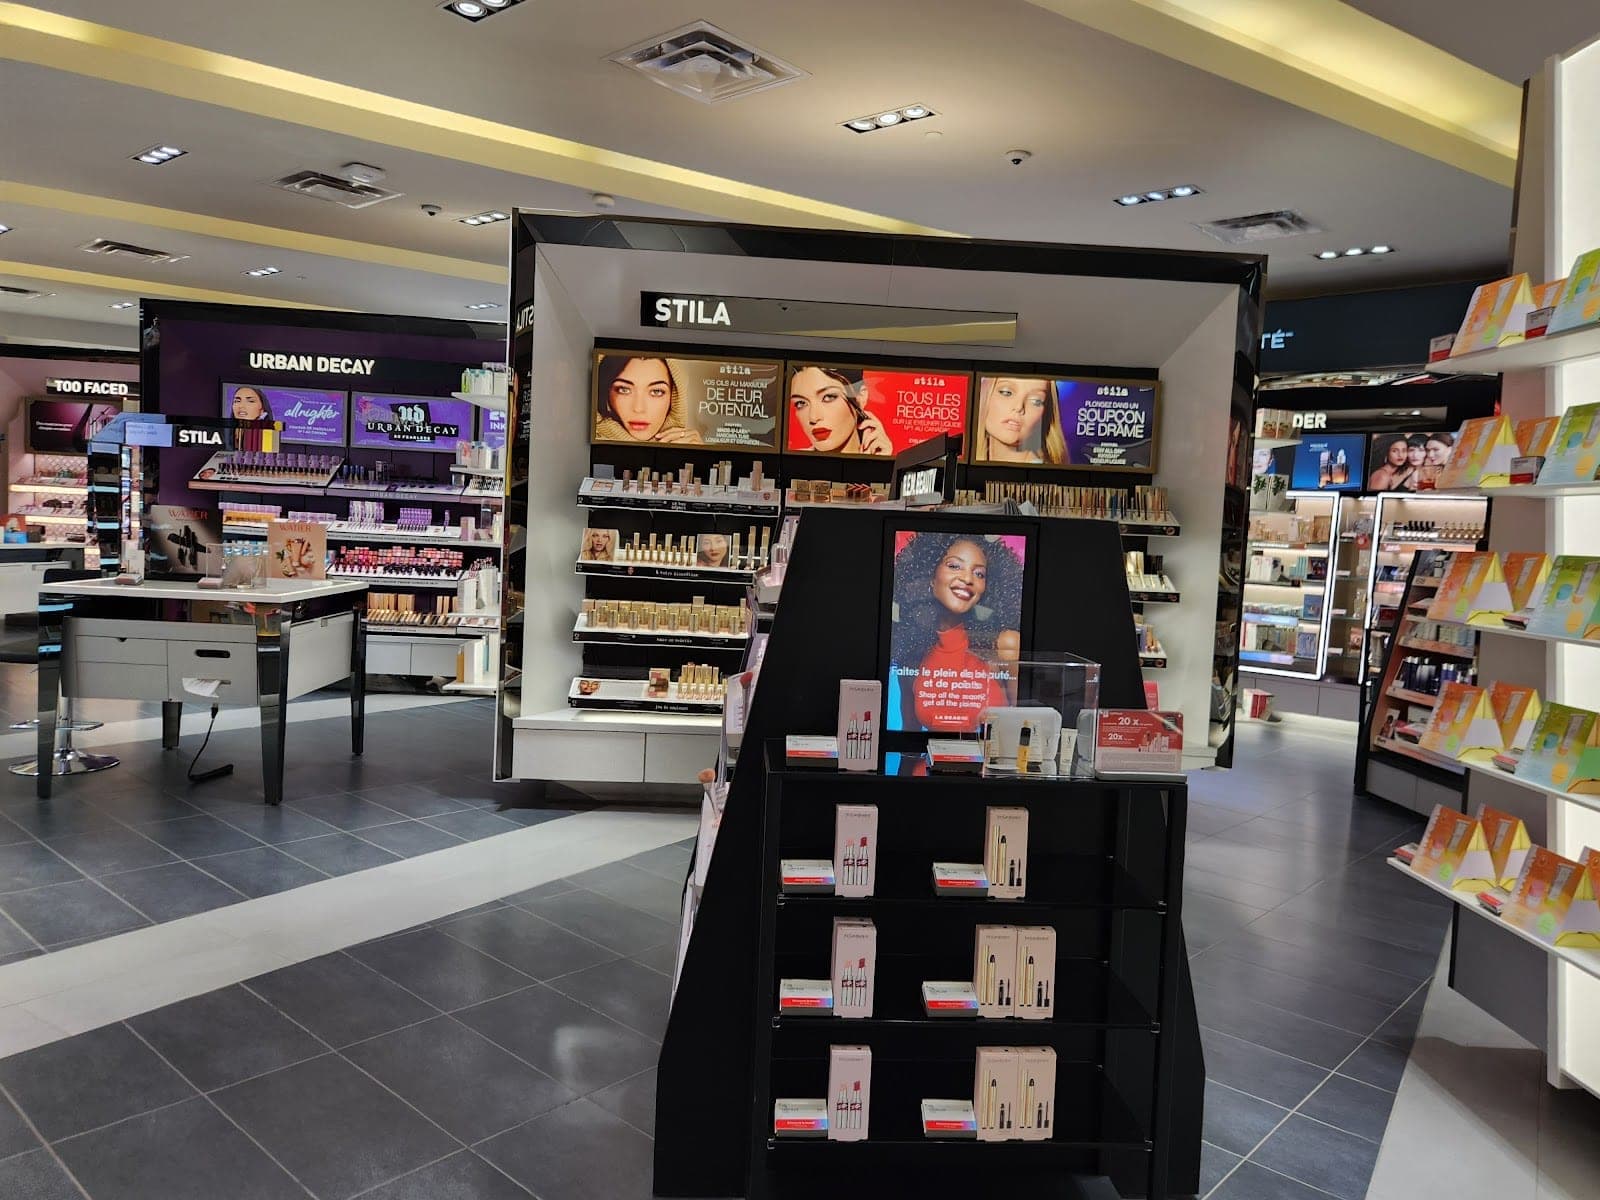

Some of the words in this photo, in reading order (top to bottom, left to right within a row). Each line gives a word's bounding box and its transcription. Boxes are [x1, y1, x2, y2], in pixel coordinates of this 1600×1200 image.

[655, 298, 731, 325] STILA
[250, 352, 312, 371] URBAN
[317, 356, 375, 375] DECAY
[720, 364, 751, 374] stila
[54, 380, 82, 393] TOO
[84, 382, 128, 395] FACED
[914, 376, 945, 386] stila
[707, 387, 725, 401] DE
[728, 388, 762, 404] LEUR
[897, 390, 933, 406] TOUS
[936, 393, 961, 407] LES
[1097, 386, 1129, 396] stila
[699, 401, 769, 418] POTENTIAL
[1113, 401, 1129, 409] DANS
[896, 405, 960, 421] REGARDS
[1078, 408, 1145, 425] SOUPÇON
[367, 422, 411, 433] URBAN
[416, 425, 457, 435] DECAY
[1292, 413, 1327, 429] DER
[179, 429, 223, 445] STILA
[1076, 421, 1096, 436] DE
[1097, 422, 1144, 438] DRAME
[168, 509, 208, 520] WATIER
[890, 666, 920, 676] Faites
[921, 667, 931, 676] le
[933, 668, 957, 679] plein
[923, 679, 933, 688] et
[935, 680, 948, 688] de
[918, 691, 936, 700] Shop
[1118, 717, 1130, 726] 20
